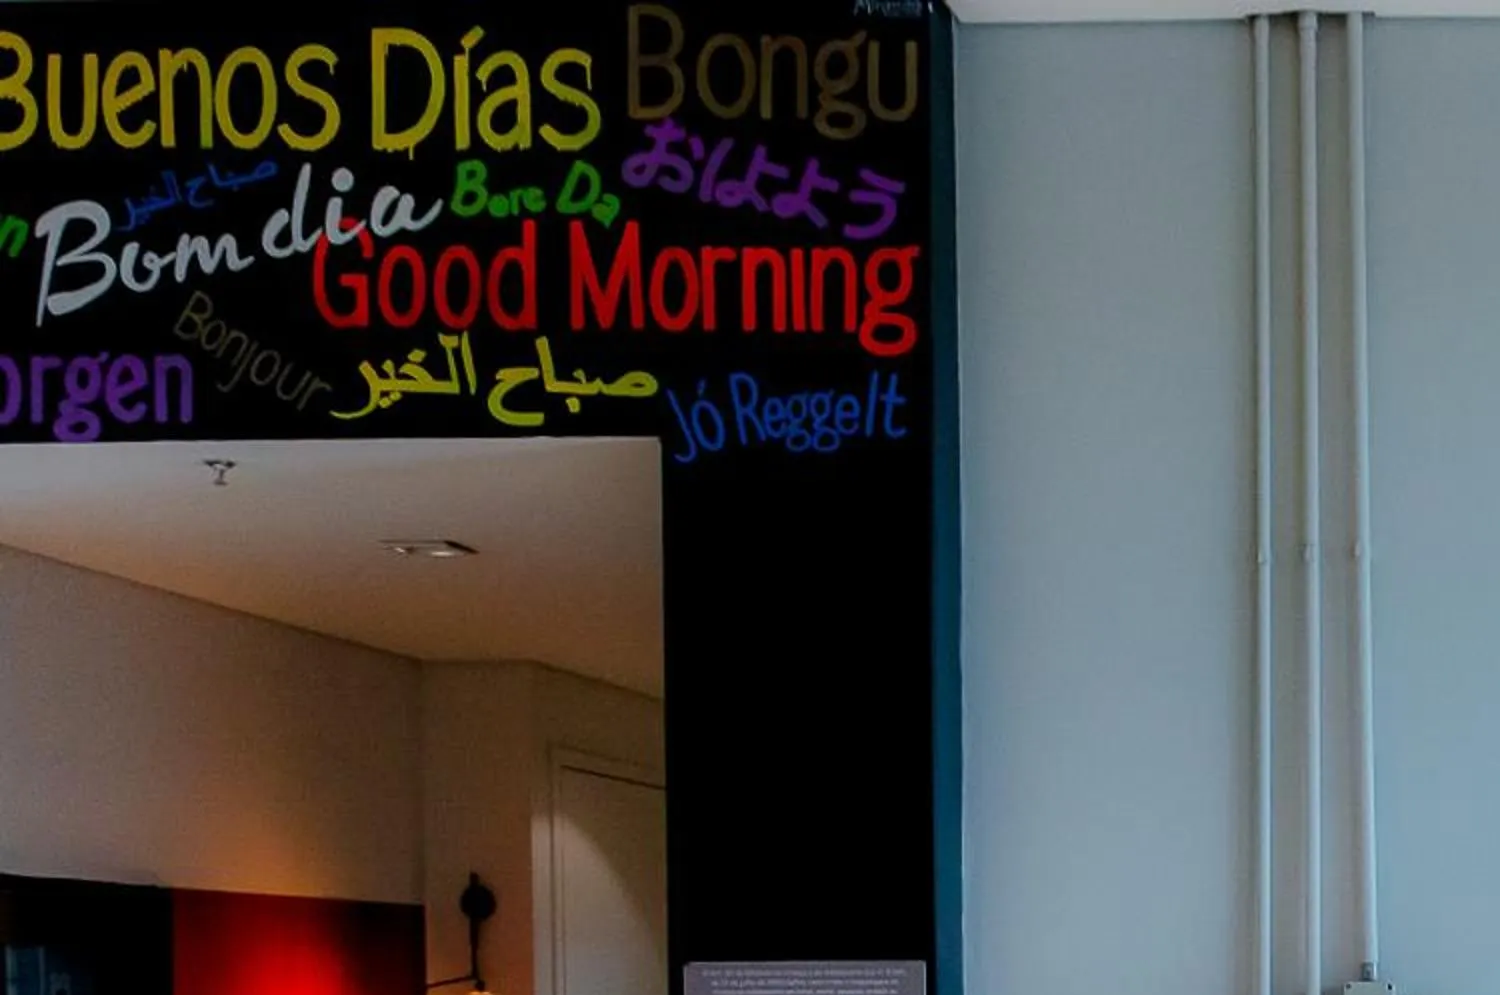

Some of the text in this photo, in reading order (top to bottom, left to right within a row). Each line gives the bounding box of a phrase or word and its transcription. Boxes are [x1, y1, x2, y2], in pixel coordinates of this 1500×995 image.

[0, 25, 601, 157] Buenos Días
[627, 3, 918, 140] Bongu
[35, 162, 443, 327] Bom dia
[556, 159, 621, 227] Da
[313, 217, 919, 357] Good Morning
[172, 290, 333, 411] Bonjour
[330, 331, 659, 427] صباح الخير
[667, 371, 907, 463] Jó Reggelt
